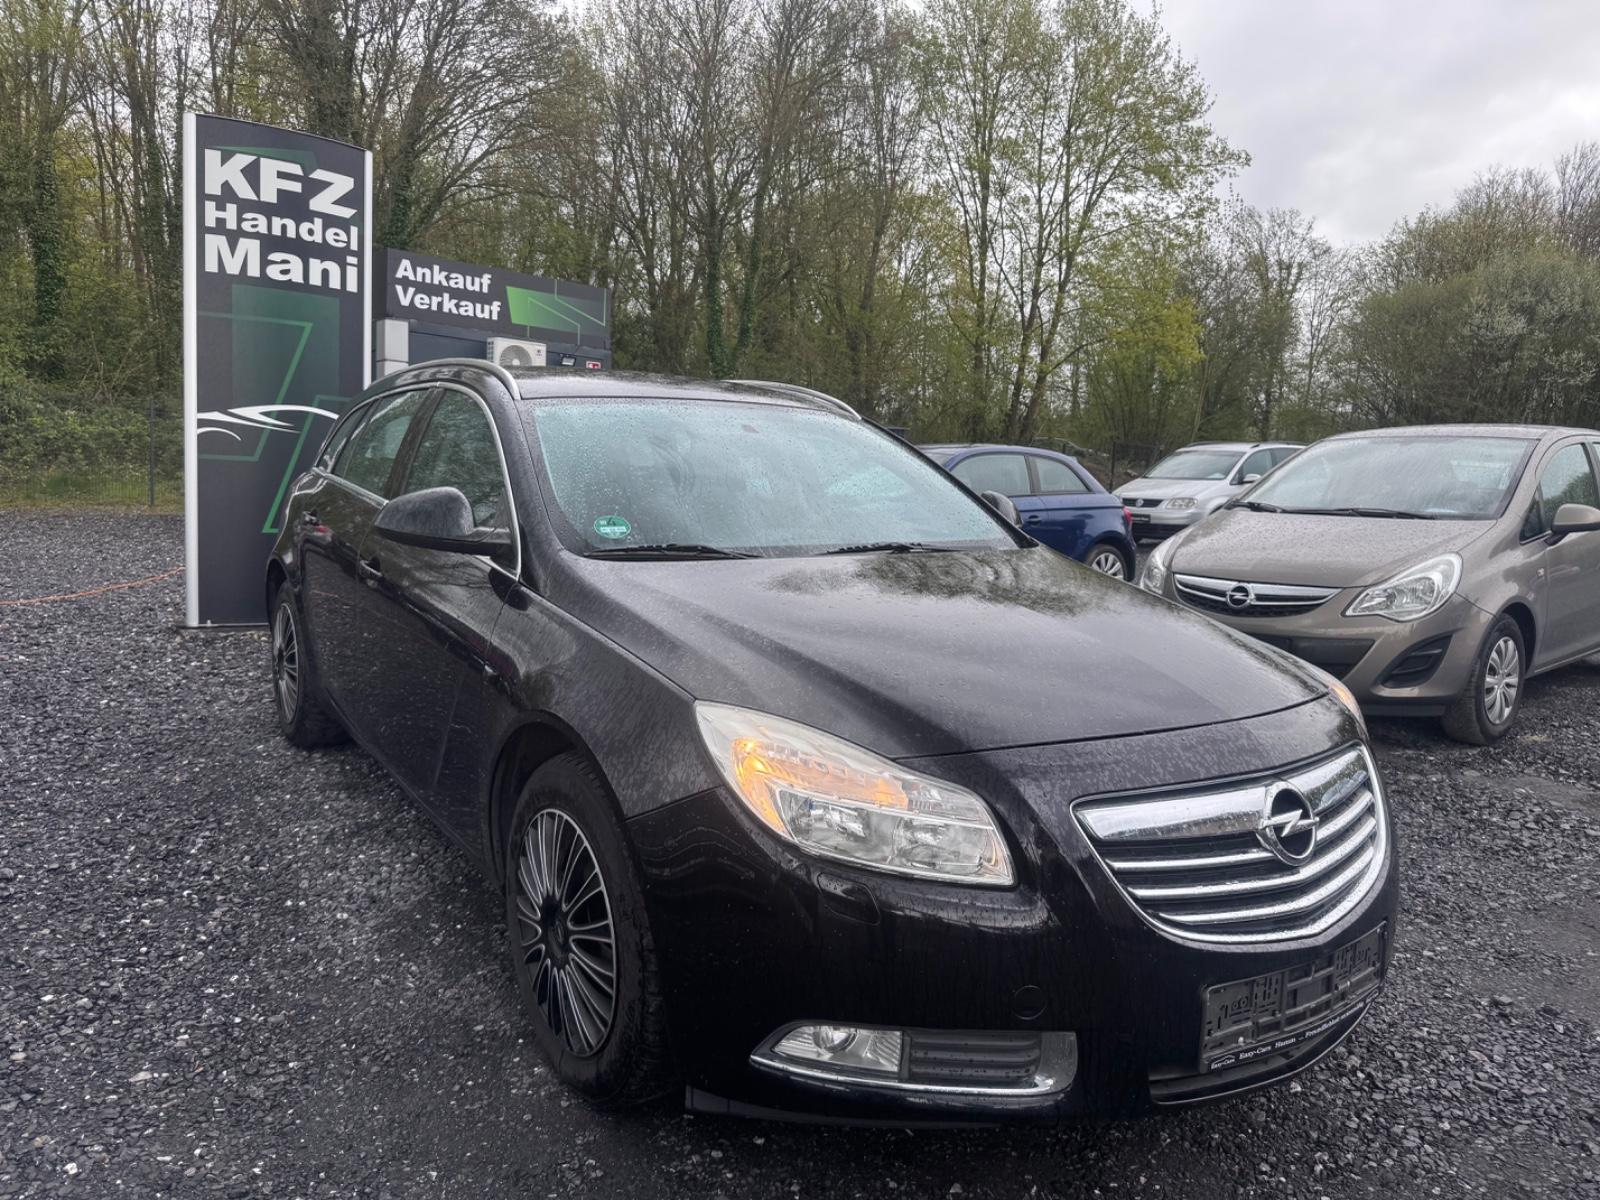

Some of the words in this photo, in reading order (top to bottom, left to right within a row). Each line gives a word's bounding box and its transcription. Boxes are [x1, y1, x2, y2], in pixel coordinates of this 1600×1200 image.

[204, 148, 358, 219] KFZ
[204, 200, 359, 251] Handel
[204, 233, 359, 293] Mani
[395, 258, 492, 294] Ankauf
[395, 284, 502, 321] Verkauf
